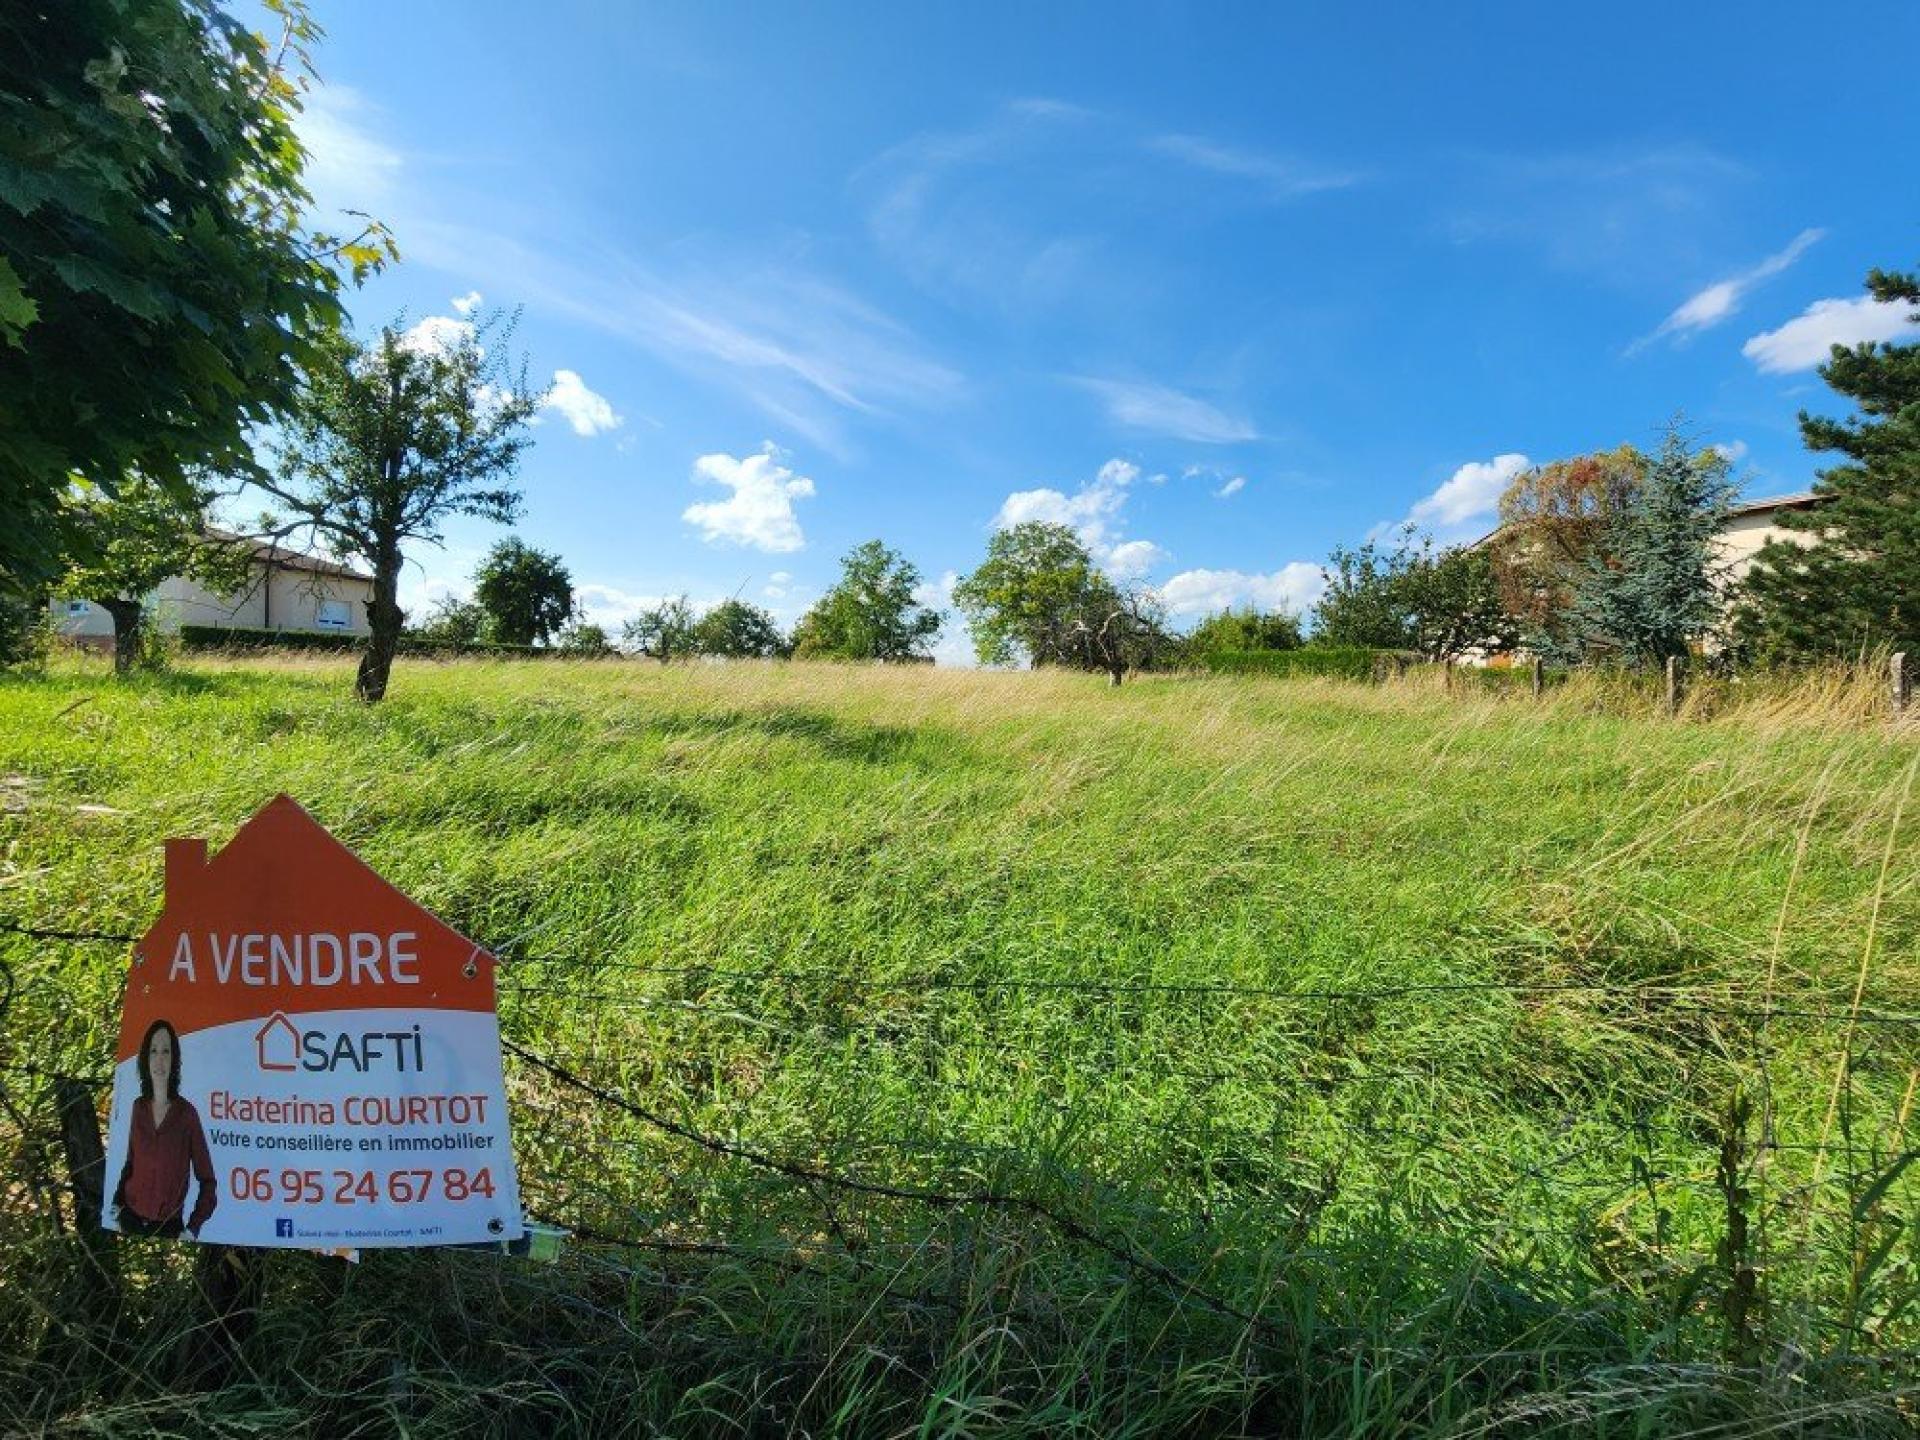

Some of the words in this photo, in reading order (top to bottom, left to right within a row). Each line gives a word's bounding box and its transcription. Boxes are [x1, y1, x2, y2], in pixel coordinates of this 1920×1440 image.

[168, 932, 197, 983] A
[209, 931, 420, 986] VENDRE
[209, 1090, 336, 1126] Ekaterina
[343, 1095, 489, 1126] COURTOT
[210, 1129, 251, 1148] Votre
[255, 1133, 353, 1152] conseillère
[358, 1138, 383, 1151] en
[388, 1132, 495, 1151] immobilier
[230, 1166, 274, 1202] 06
[280, 1169, 325, 1204] 95
[333, 1170, 379, 1204] 24
[388, 1170, 433, 1203] 67
[442, 1166, 496, 1201] 84
